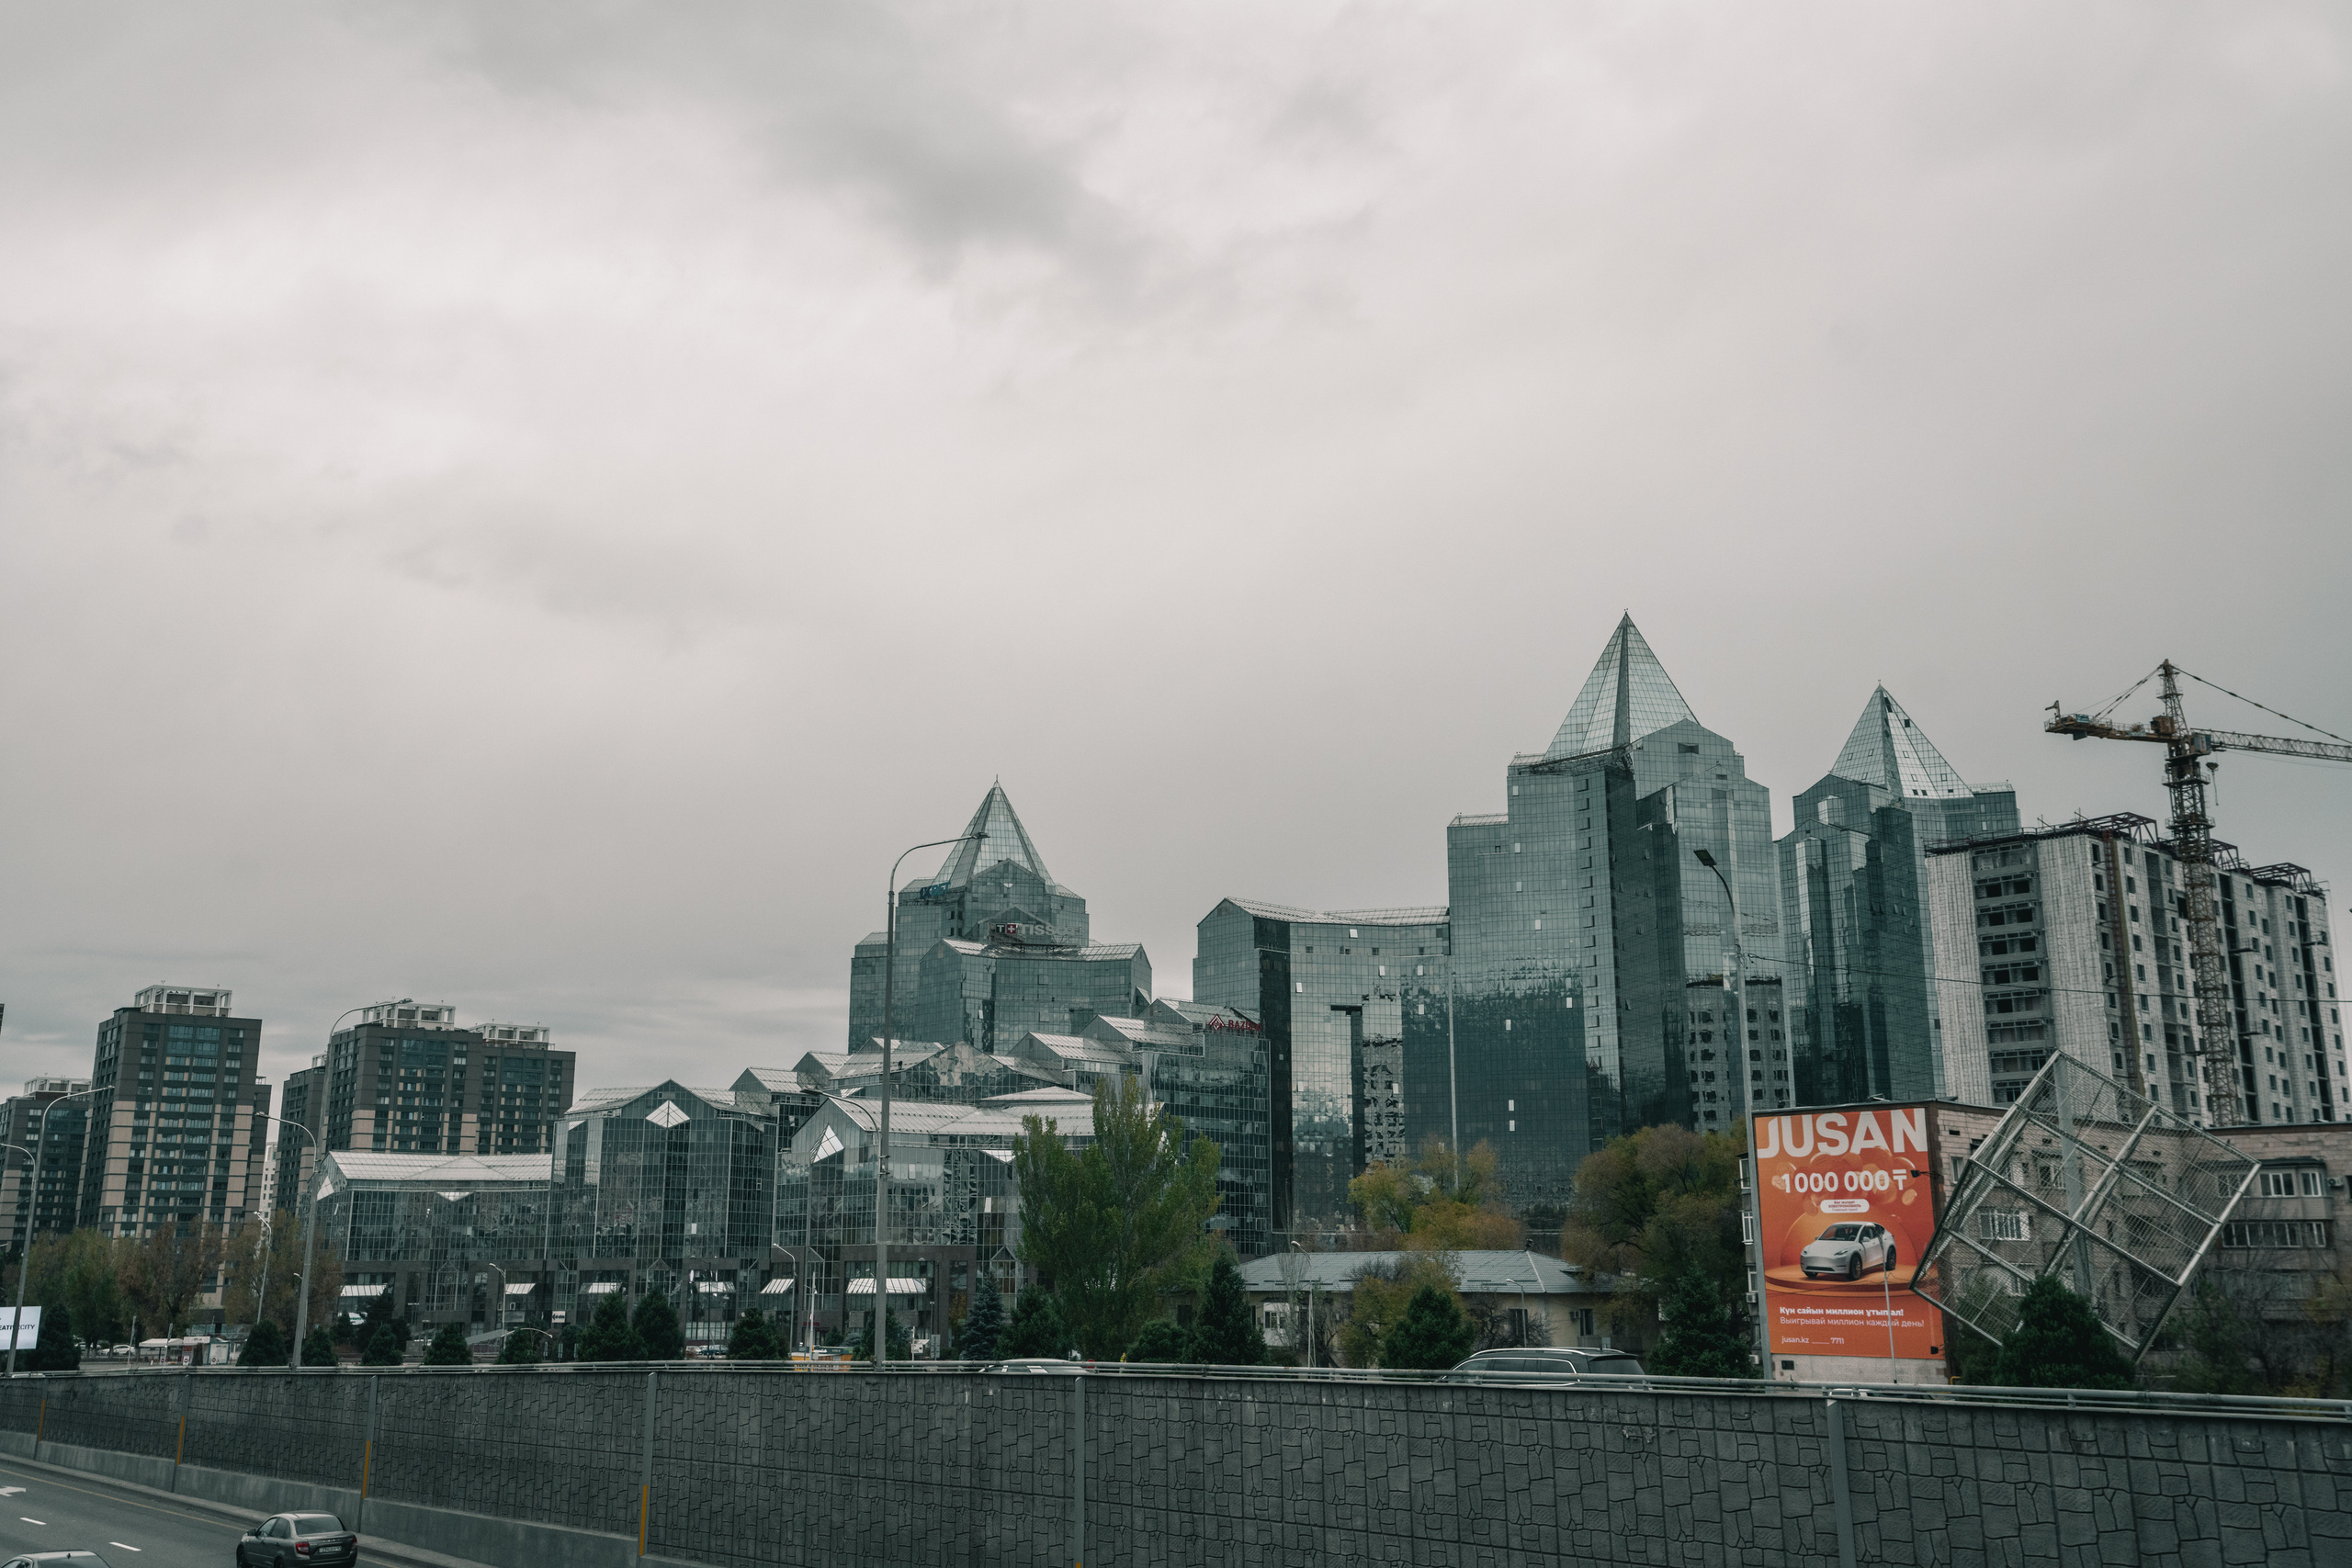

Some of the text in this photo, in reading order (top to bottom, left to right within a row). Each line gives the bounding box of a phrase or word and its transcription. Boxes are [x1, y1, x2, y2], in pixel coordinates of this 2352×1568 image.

[1757, 1108, 1928, 1158] JUSAN
[1779, 1306, 1795, 1315] Күн
[1780, 1317, 1826, 1325] Выигрывай
[1781, 1336, 1809, 1344] jusan.kz
